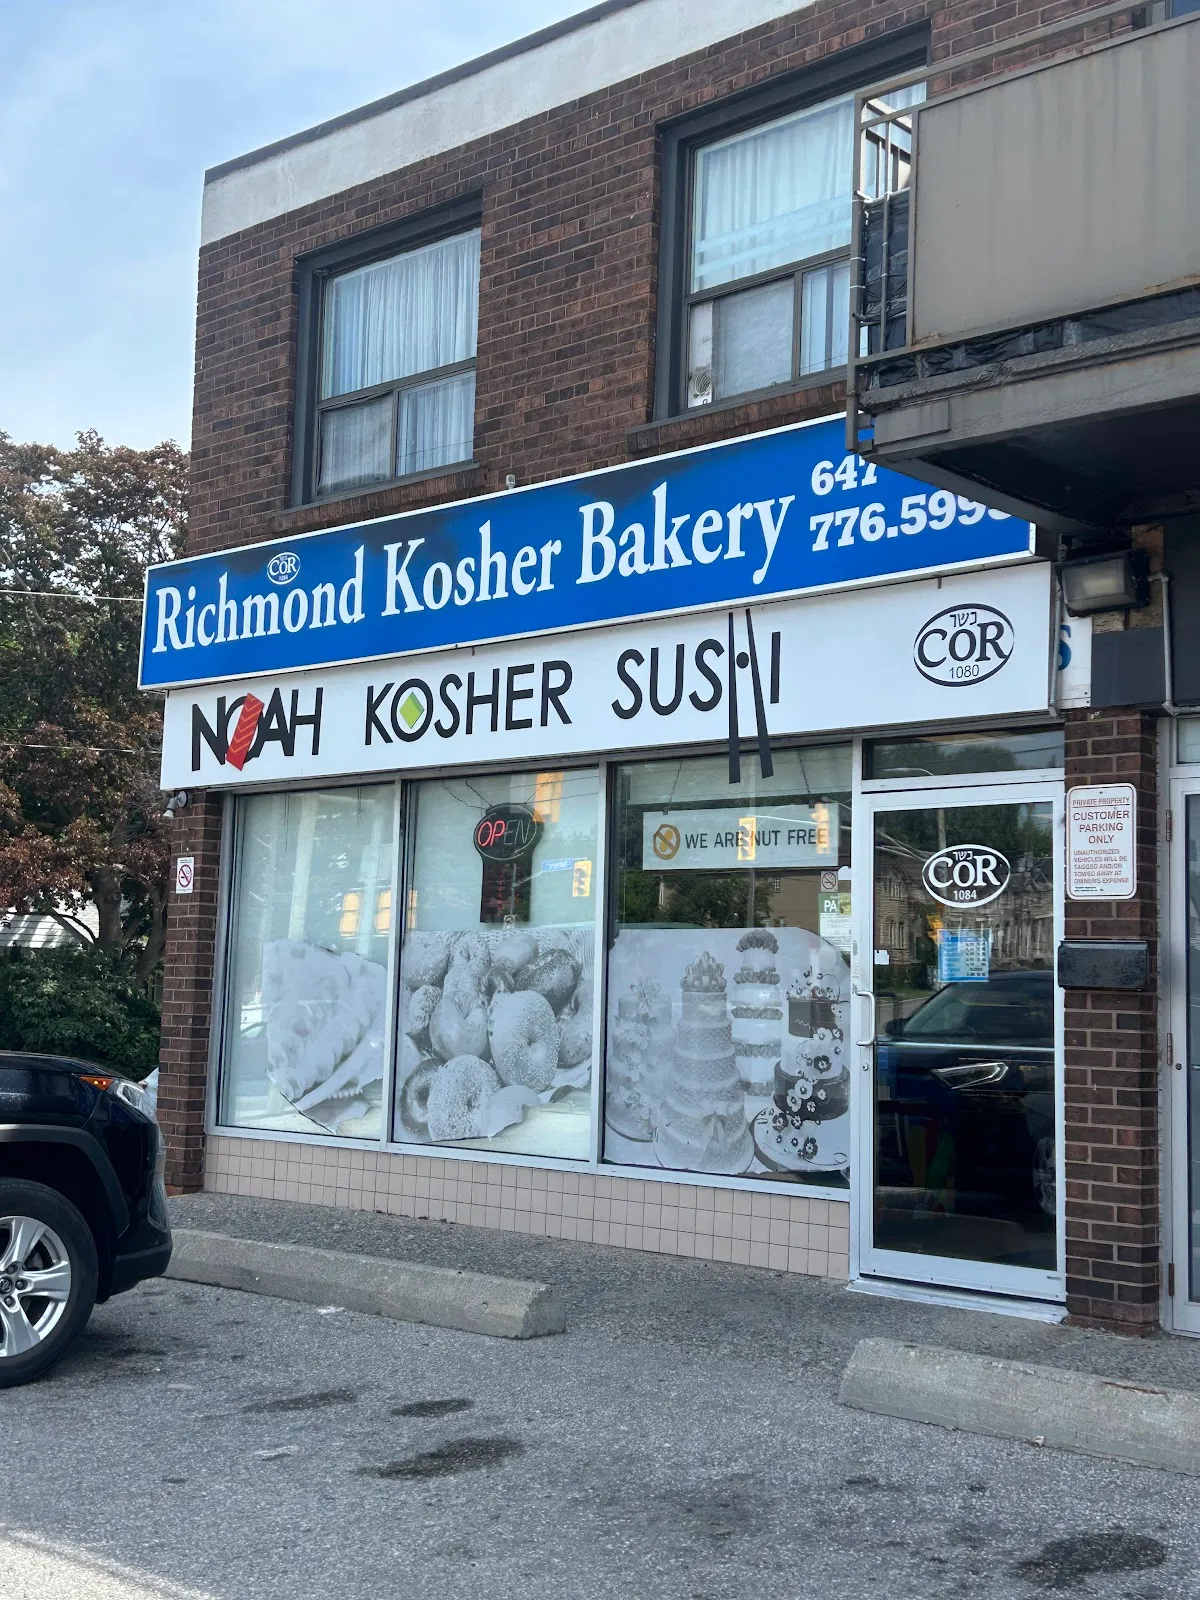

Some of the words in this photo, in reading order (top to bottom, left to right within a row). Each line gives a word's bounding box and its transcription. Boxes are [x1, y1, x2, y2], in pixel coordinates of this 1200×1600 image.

[152, 544, 366, 653] Richmond
[381, 519, 562, 617] Kosher
[575, 481, 796, 585] Bakery
[918, 620, 1008, 668] COR
[948, 664, 980, 679] 1080
[191, 687, 324, 772] NOAH
[364, 659, 573, 746] KOSHER
[611, 608, 781, 784] SUSHI
[1072, 798, 1098, 806] PRIVATE
[1098, 796, 1130, 805] PROPERTY
[1073, 810, 1130, 821] CUSTOMER
[477, 818, 533, 847] OPEN
[1079, 822, 1124, 832] PARKING
[685, 832, 708, 849] WE
[713, 831, 744, 848] ARE
[750, 830, 781, 847] NUT
[787, 828, 828, 846] FREE
[1088, 834, 1114, 844] ONLY
[928, 855, 1001, 888] COR
[953, 889, 978, 900] 1084
